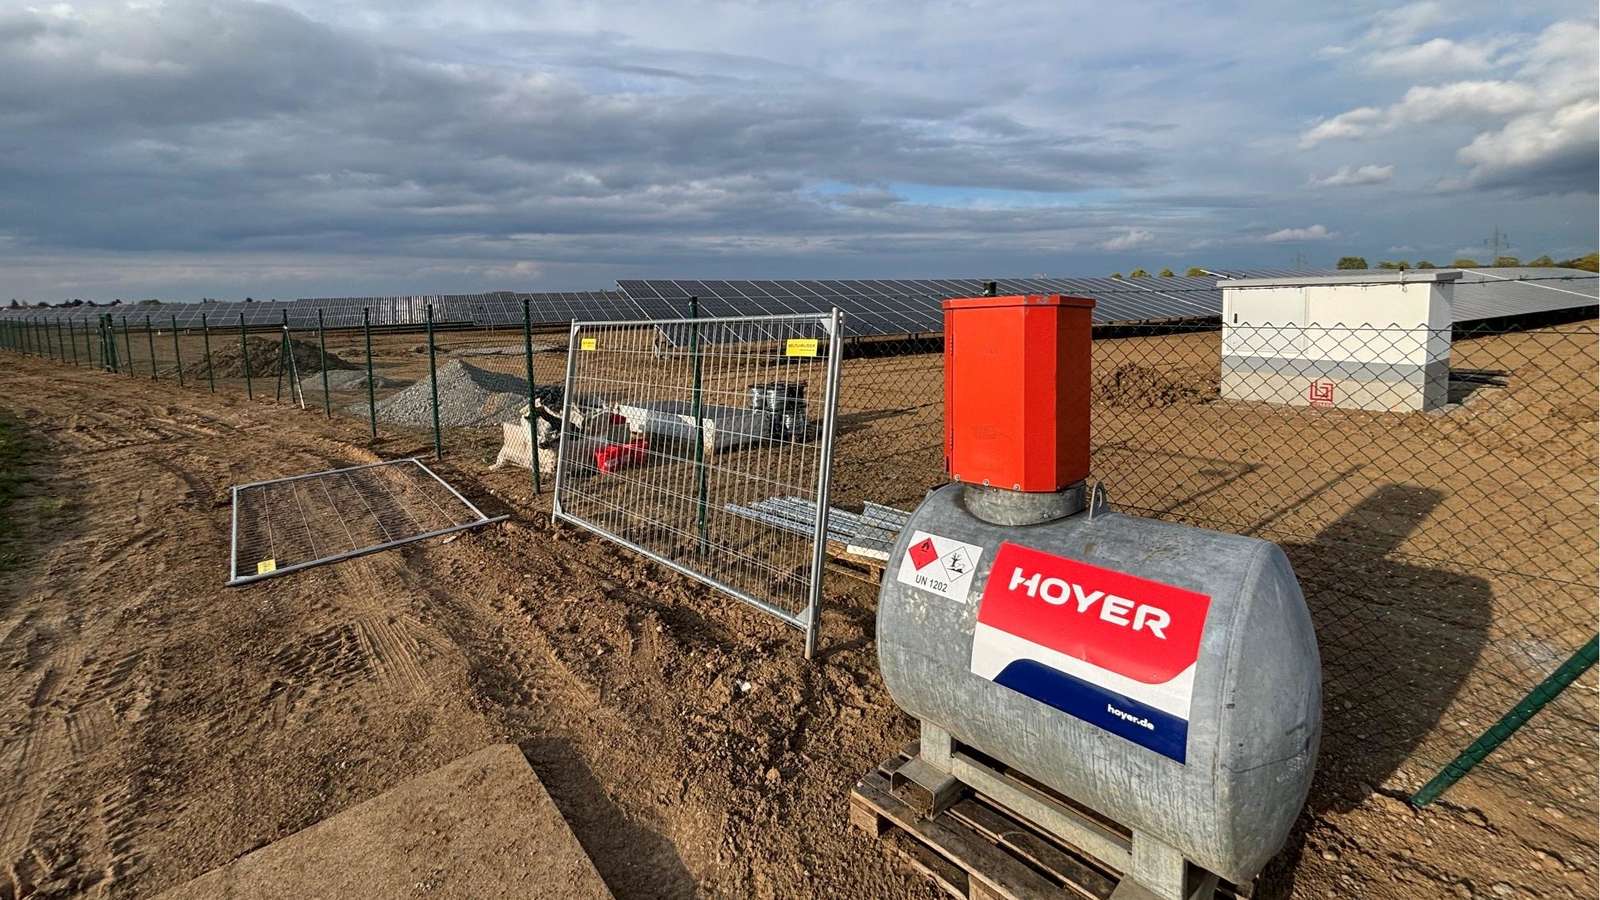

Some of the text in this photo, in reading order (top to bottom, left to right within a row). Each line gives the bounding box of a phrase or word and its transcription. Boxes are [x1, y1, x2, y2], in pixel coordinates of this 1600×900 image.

[915, 575, 948, 592] UN 1202
[1008, 567, 1171, 640] HOYER
[1107, 703, 1155, 731] hoyer.de
